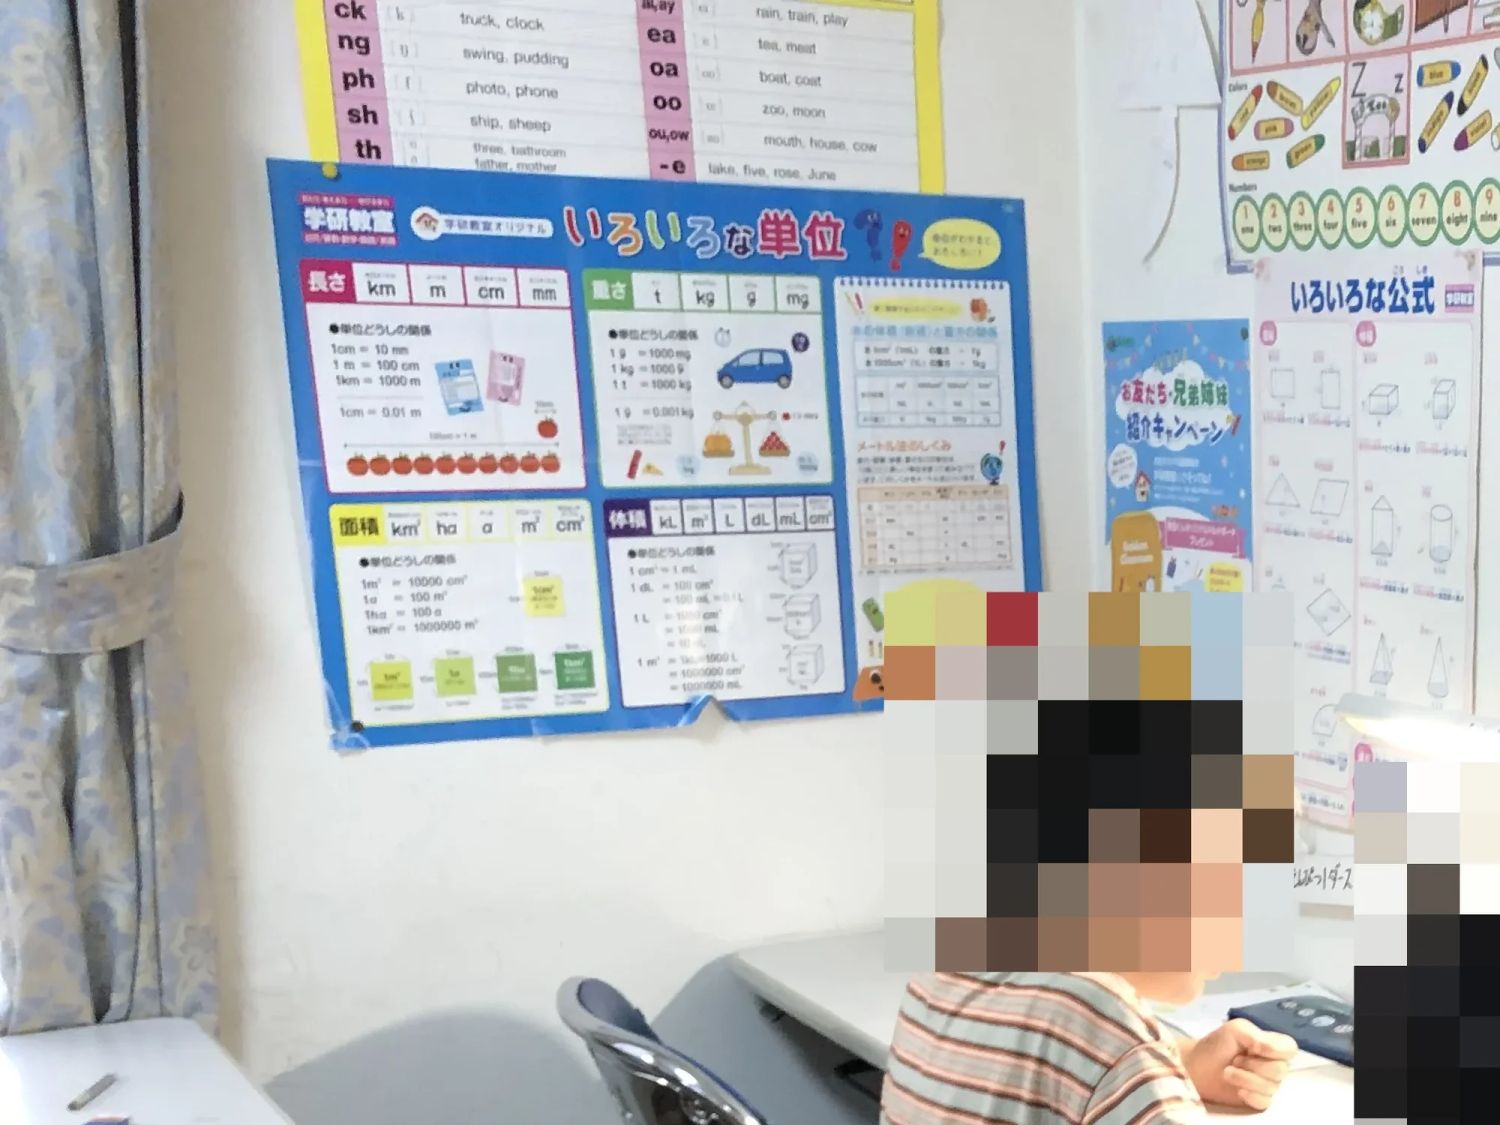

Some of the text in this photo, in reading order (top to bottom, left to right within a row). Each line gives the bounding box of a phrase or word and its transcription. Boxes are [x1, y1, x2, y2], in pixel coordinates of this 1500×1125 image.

[335, 2, 366, 20] ck
[506, 16, 544, 31] clock
[823, 11, 848, 27] play
[647, 27, 676, 43] ea
[338, 33, 370, 56] ng
[787, 41, 816, 54] meat
[514, 51, 569, 69] pudding
[650, 61, 678, 78] oa
[343, 68, 374, 91] ph
[795, 74, 822, 87] coat
[1351, 62, 1367, 97] Z
[515, 84, 558, 99] phone
[653, 95, 682, 111] oo
[348, 104, 378, 125] sh
[793, 107, 826, 119] moon
[509, 117, 551, 132] sheep
[649, 128, 689, 143] ou,ow
[355, 139, 381, 160] th
[853, 141, 877, 153] cow
[808, 168, 836, 181] June
[1229, 183, 1257, 193] Numbers
[1388, 195, 1395, 210] 6
[1419, 193, 1426, 209] 7
[1454, 191, 1461, 206] 8
[1486, 189, 1493, 204] 9
[1242, 205, 1248, 219] 1
[1270, 203, 1277, 217] 2
[1298, 202, 1305, 216] 3
[1327, 199, 1335, 214] 4
[1355, 197, 1363, 212] 5
[304, 206, 394, 232] 学研教室
[1323, 219, 1338, 230] four
[1352, 217, 1367, 230] five
[1385, 217, 1396, 228] six
[1411, 215, 1437, 226] seven
[1446, 213, 1468, 227] eight
[1480, 212, 1497, 223] nine
[564, 206, 846, 260] いろいろな単位
[1241, 226, 1254, 234] one
[1268, 223, 1282, 232] two
[1293, 222, 1312, 232] three
[308, 270, 345, 292] 長さ
[367, 282, 396, 297] km
[430, 285, 446, 298] m
[478, 285, 504, 299] cm
[533, 287, 557, 301] mm
[653, 289, 661, 305] t
[1292, 276, 1434, 313] いろいろな公式
[696, 289, 715, 307] kg
[746, 291, 756, 308] g
[786, 293, 809, 309] mg
[1127, 412, 1223, 442] 紹介キャンペーン
[660, 516, 677, 529] kL
[725, 513, 735, 527] L
[752, 513, 770, 526] dL
[780, 513, 801, 526] mL
[436, 521, 457, 536] ha
[482, 522, 492, 534] a
